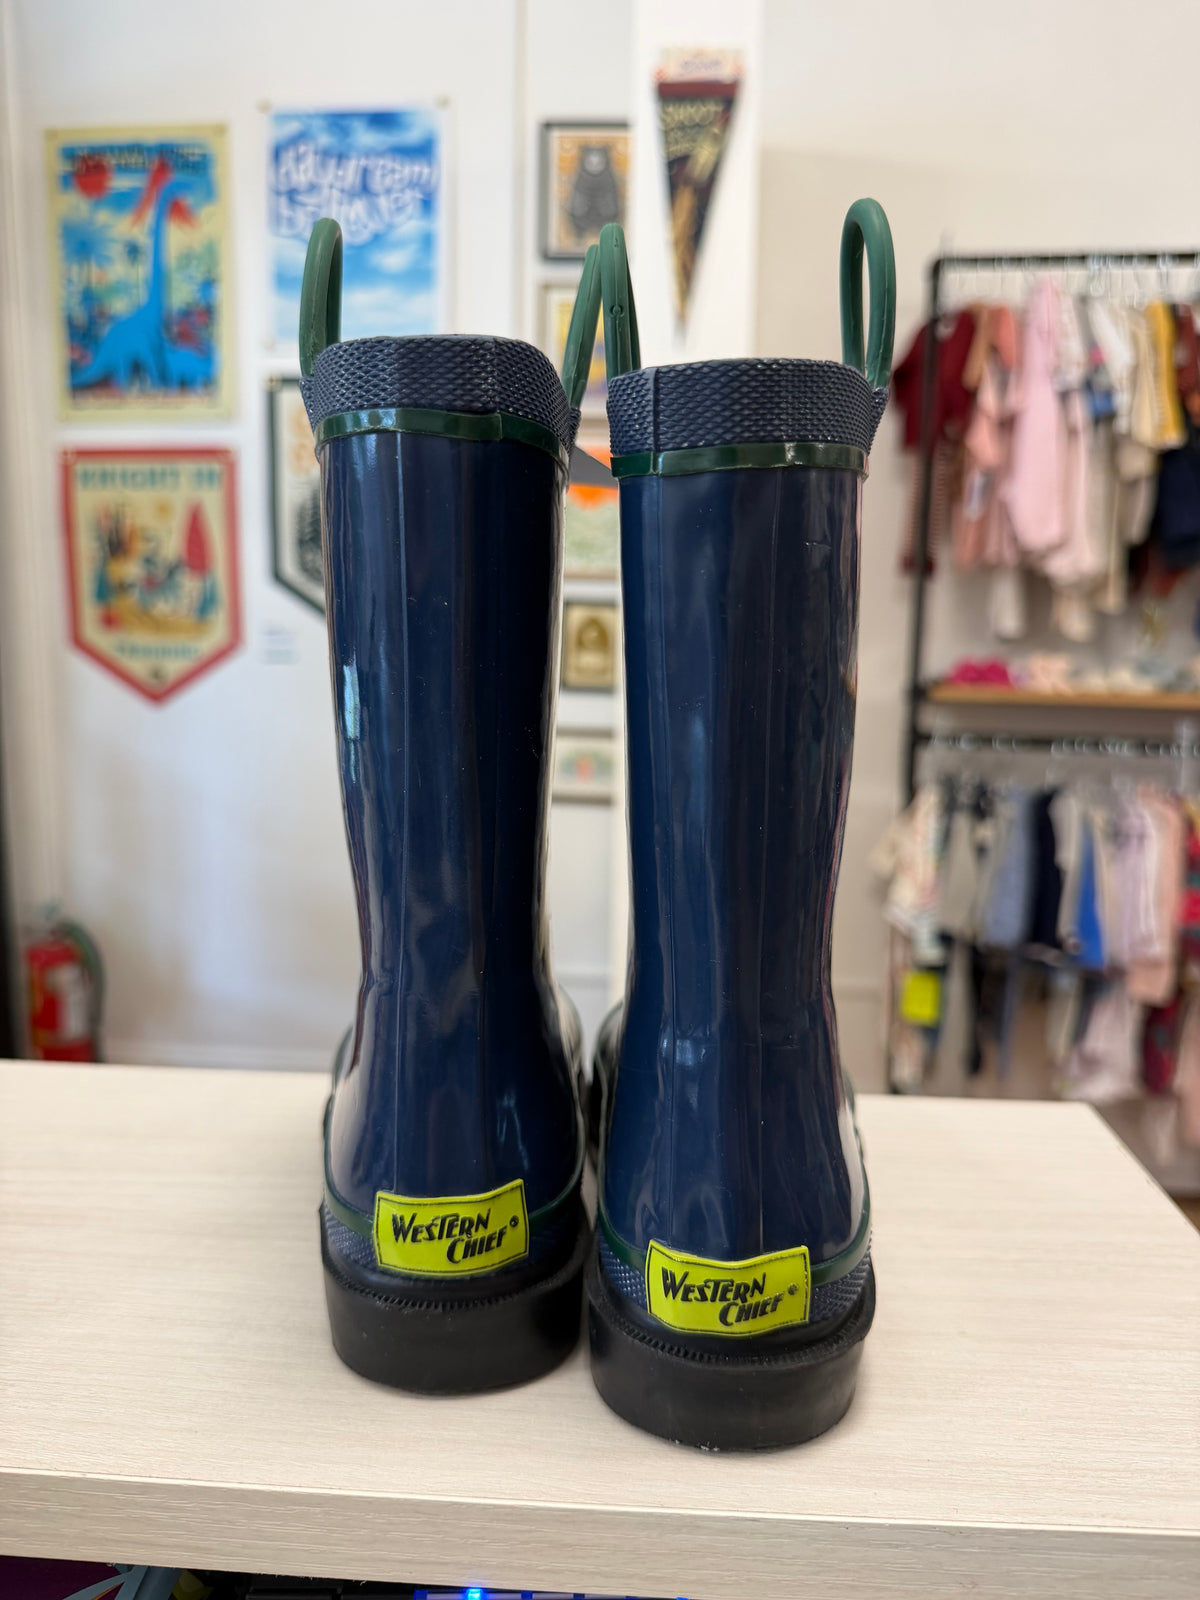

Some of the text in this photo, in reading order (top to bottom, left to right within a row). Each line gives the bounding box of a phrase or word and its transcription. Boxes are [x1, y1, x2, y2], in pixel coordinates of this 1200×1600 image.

[391, 1208, 491, 1243] WESTERN
[446, 1225, 508, 1264] CHIEF
[661, 1266, 767, 1304] WESTERN
[718, 1291, 784, 1326] CHIEF
